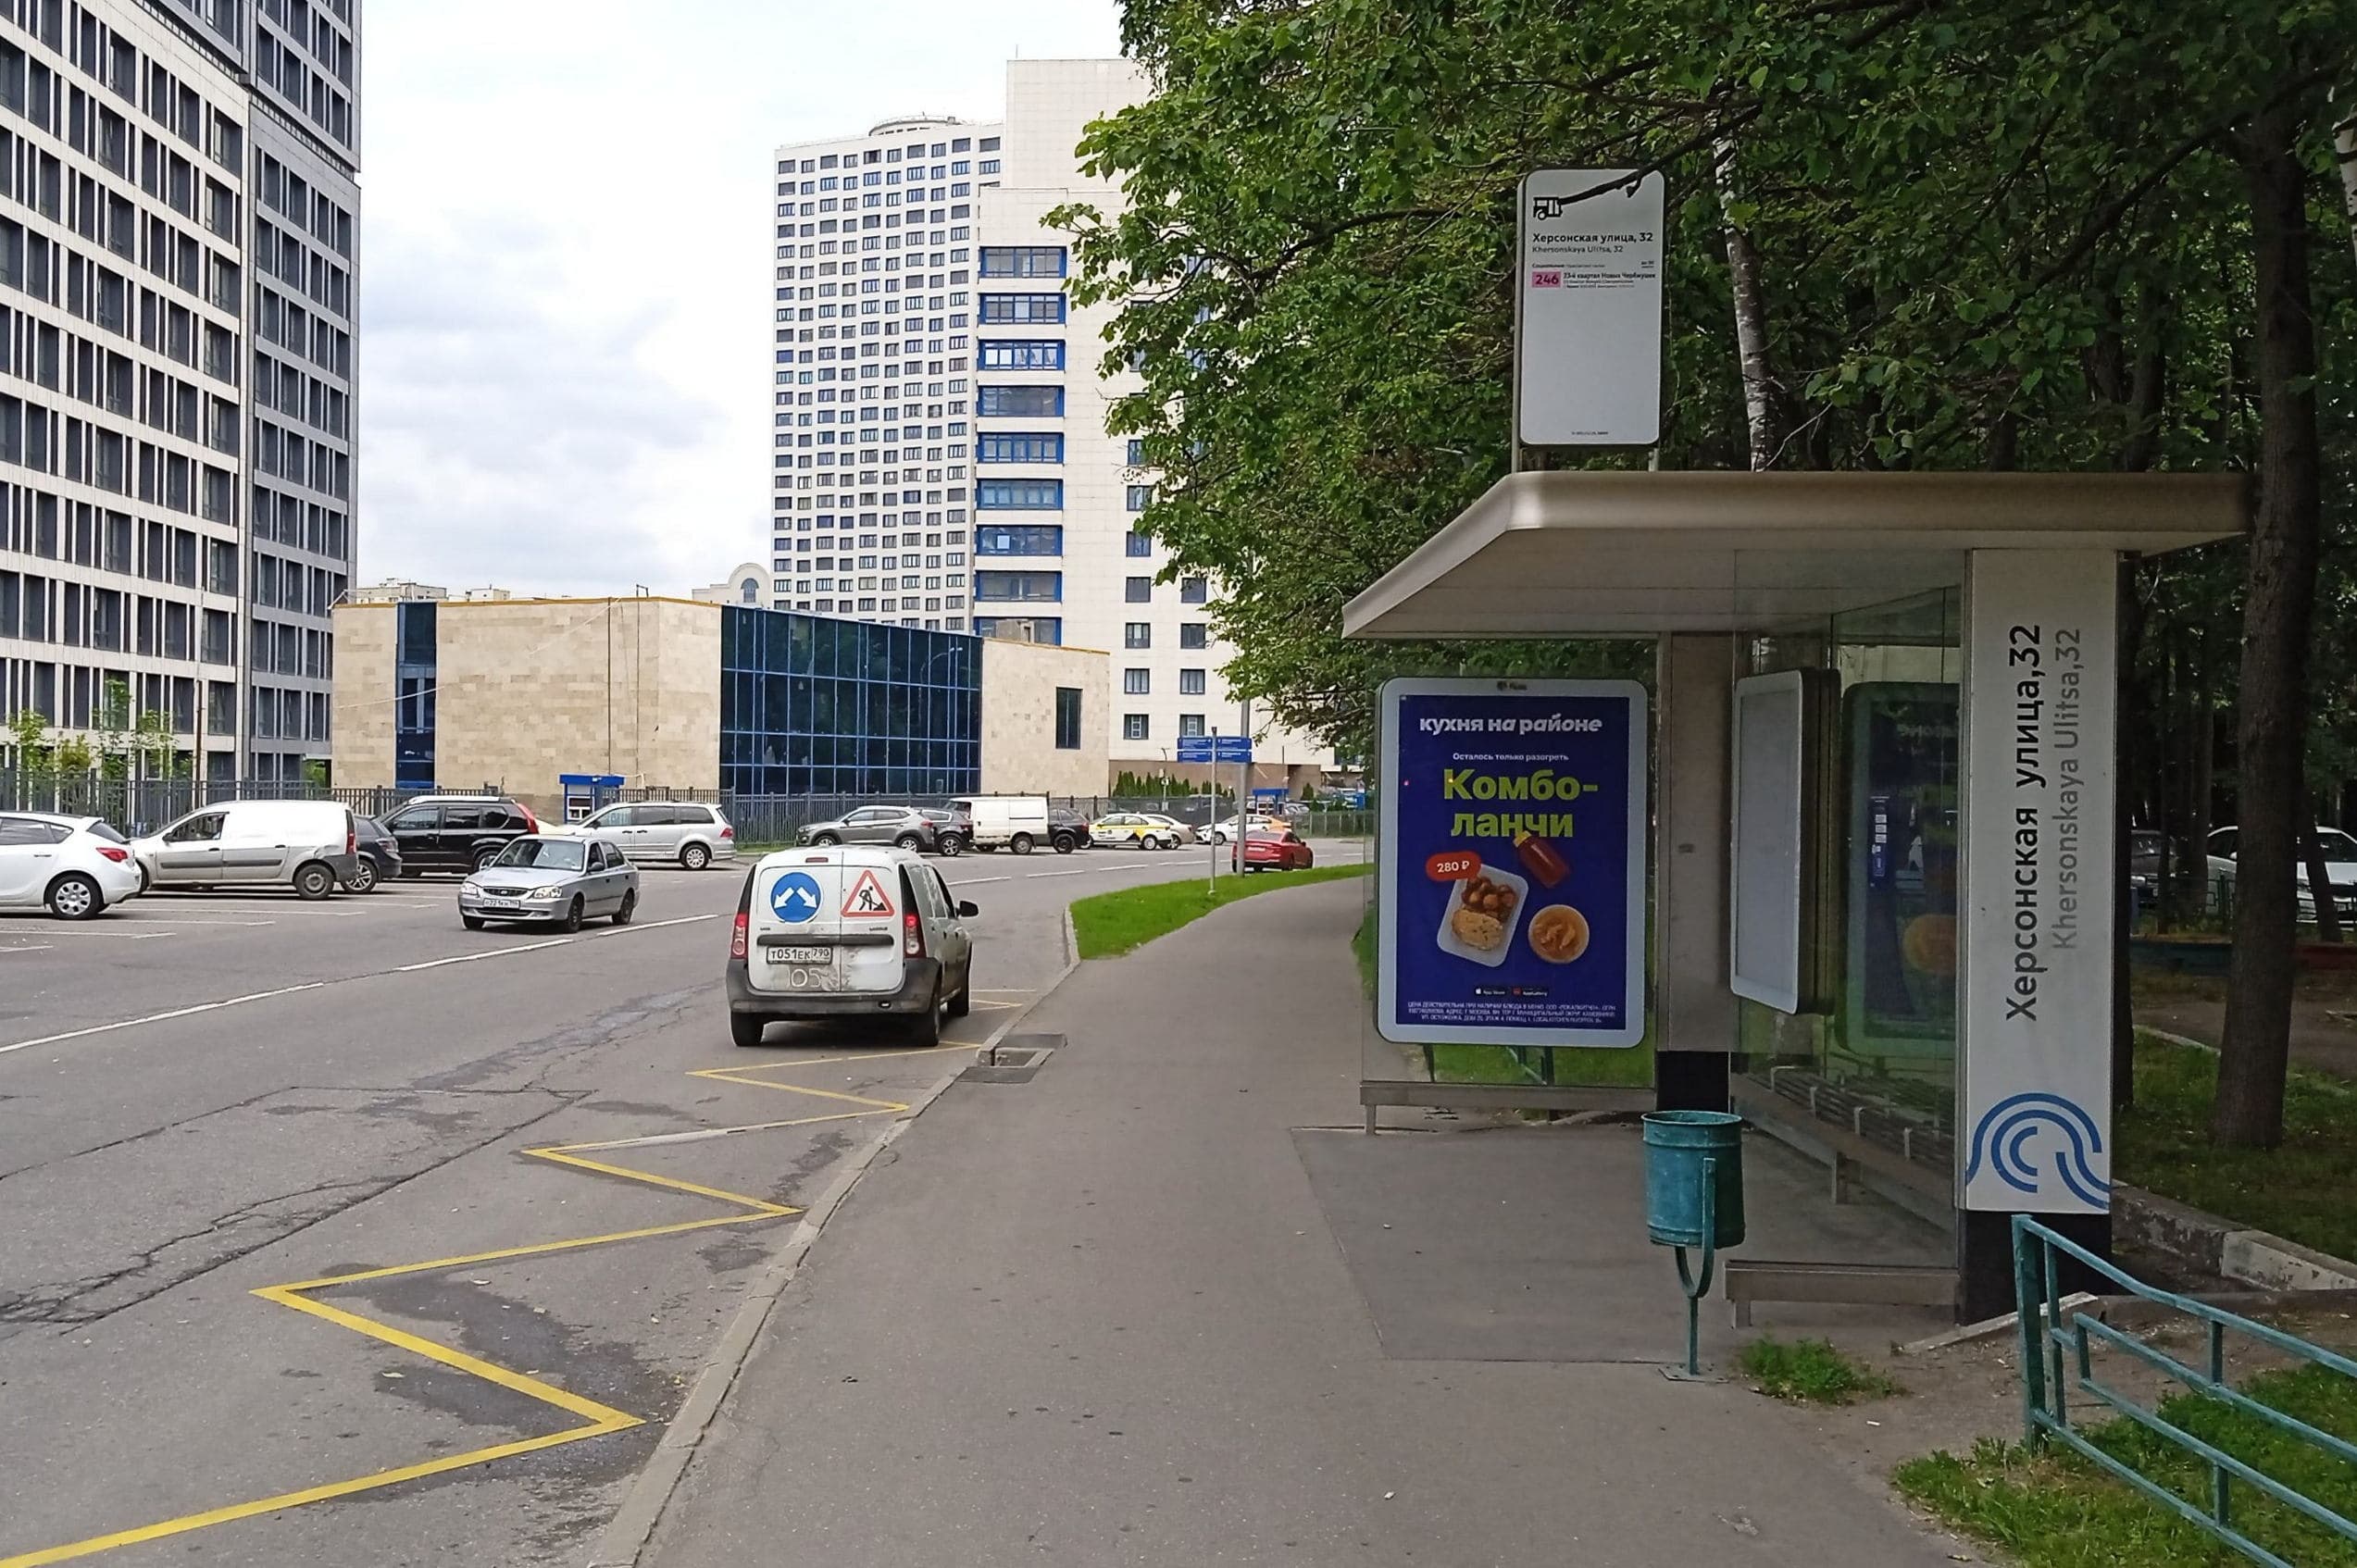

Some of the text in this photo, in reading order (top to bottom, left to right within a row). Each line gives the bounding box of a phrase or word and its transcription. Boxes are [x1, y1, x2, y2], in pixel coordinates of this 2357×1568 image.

[1532, 232, 1653, 244] Херсонская улица, 32
[1532, 245, 1586, 255] Khersonskaya
[1535, 274, 1559, 285] 246
[1419, 713, 1603, 736] кухня на районе
[1453, 752, 1494, 761] Осталось
[1525, 753, 1569, 763] разогреть
[1443, 767, 1599, 801] Комбо-
[1450, 813, 1574, 838] ланчи
[2052, 759, 2084, 950] Khersonskaya
[1436, 861, 1460, 873] 280
[2005, 807, 2048, 1021] Херсонская
